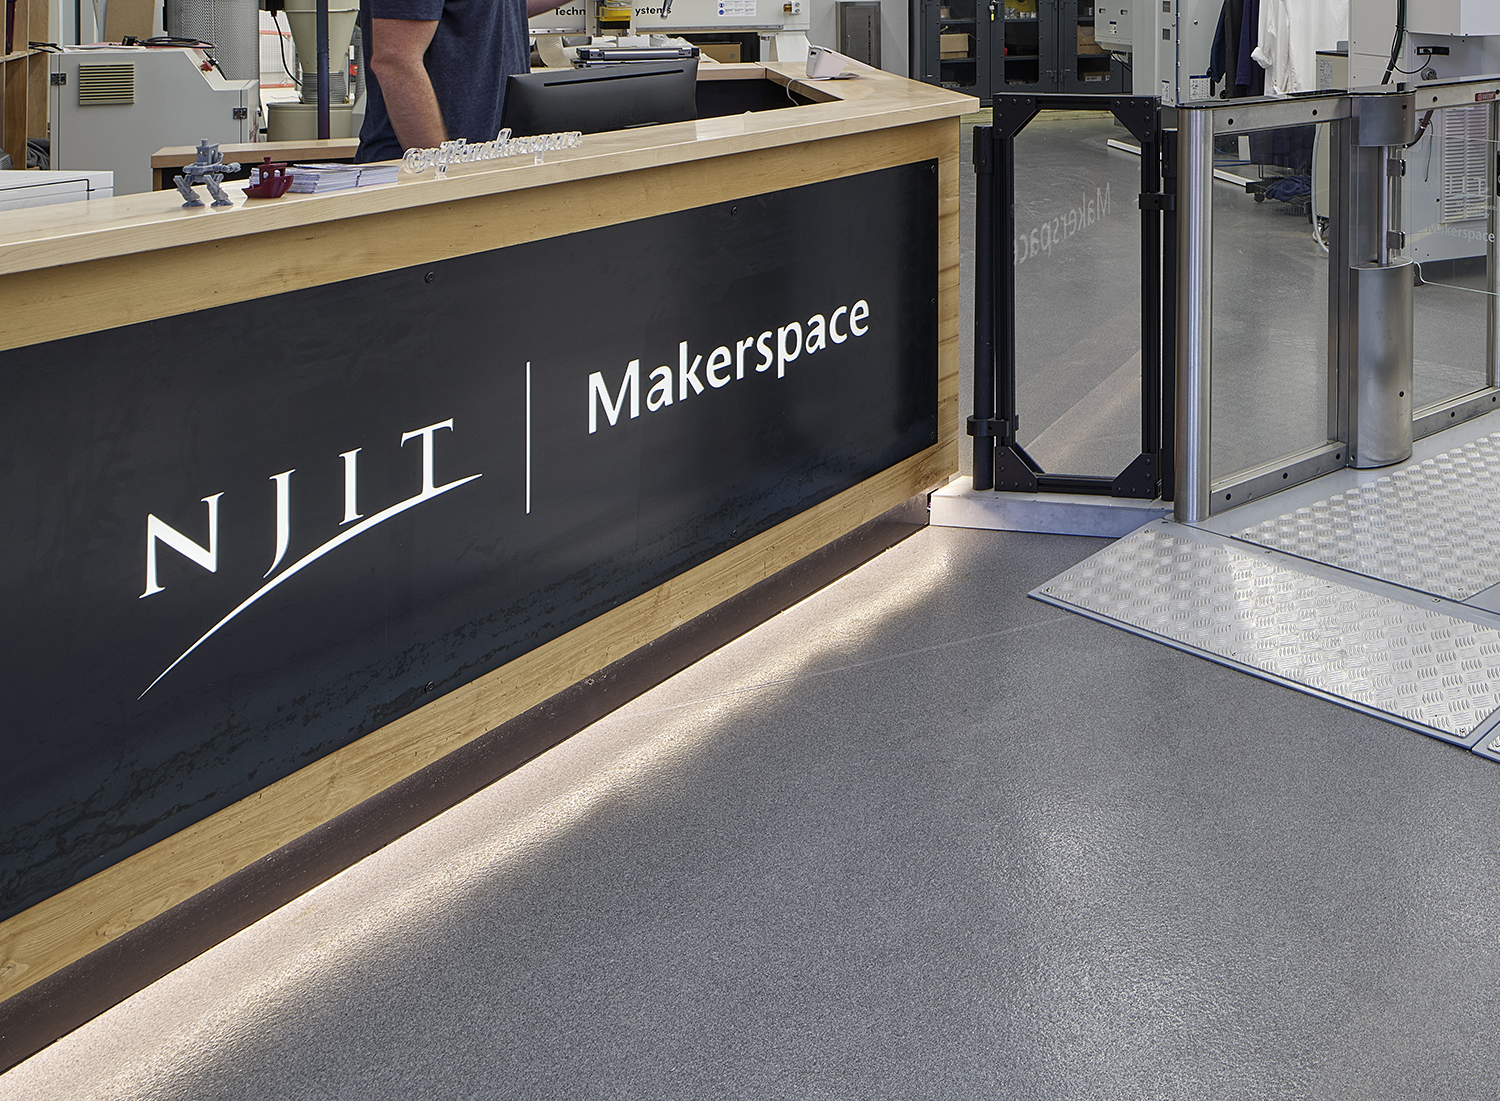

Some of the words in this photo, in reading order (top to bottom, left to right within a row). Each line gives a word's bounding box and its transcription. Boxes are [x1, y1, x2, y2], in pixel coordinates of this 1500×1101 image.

[555, 6, 586, 16] Techn
[635, 6, 672, 17] ystems
[588, 298, 870, 435] Makerspace
[138, 417, 454, 600] NJIT
